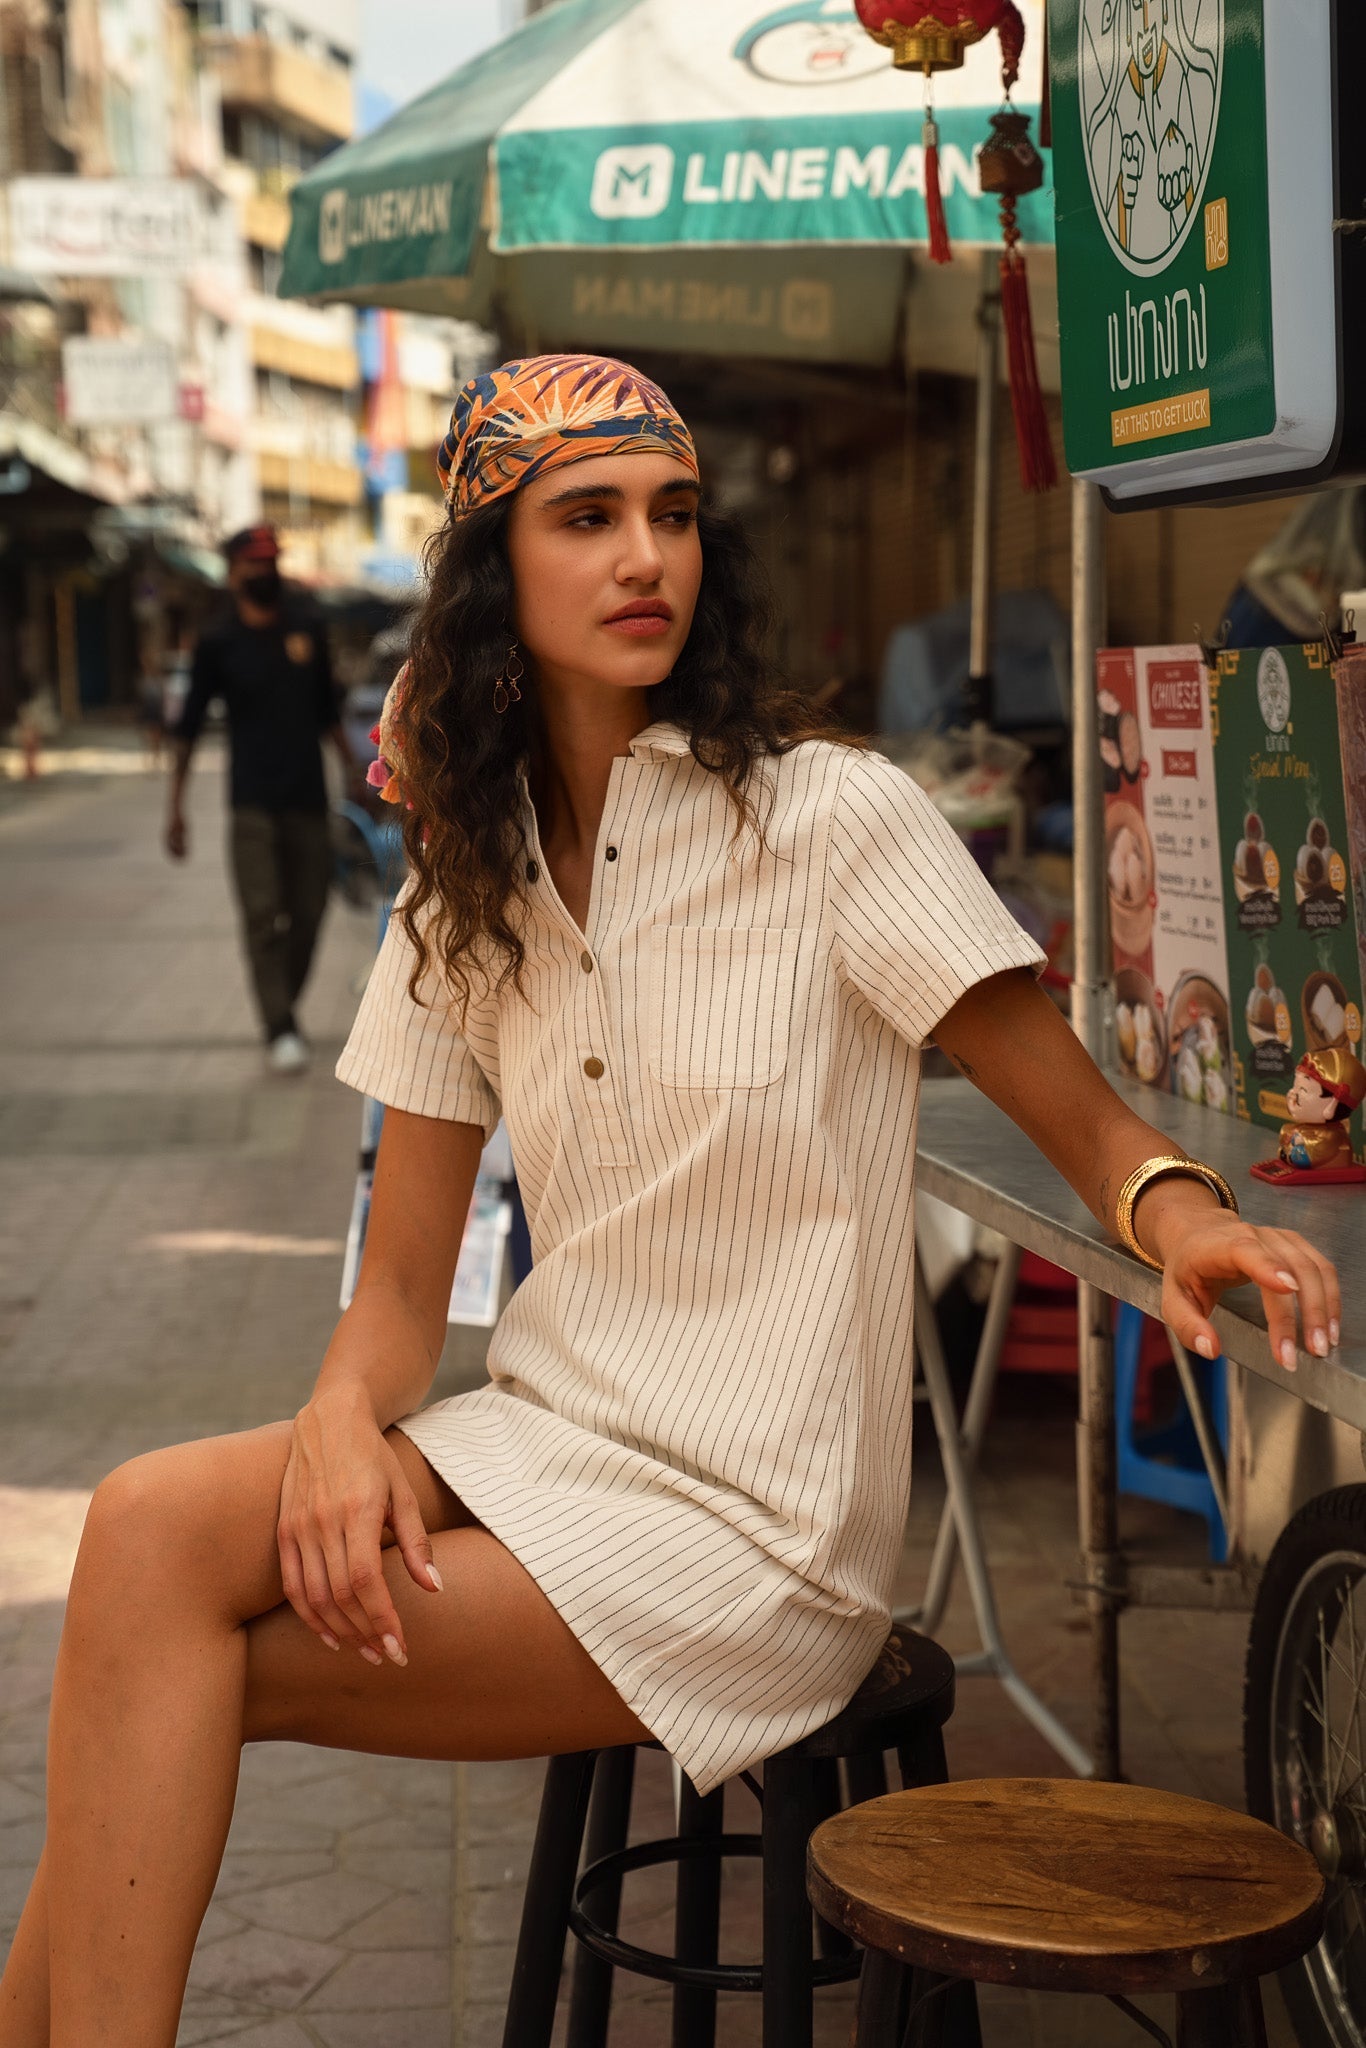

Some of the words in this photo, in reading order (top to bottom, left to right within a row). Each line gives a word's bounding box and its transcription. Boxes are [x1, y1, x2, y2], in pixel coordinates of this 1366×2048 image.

[683, 147, 830, 204] LINE
[1114, 417, 1129, 438] EAT
[1131, 412, 1149, 434] THIS
[1151, 409, 1163, 430] TO
[1163, 405, 1181, 427] GET
[1182, 397, 1207, 423] LUCK
[1151, 681, 1200, 711] CHINESE
